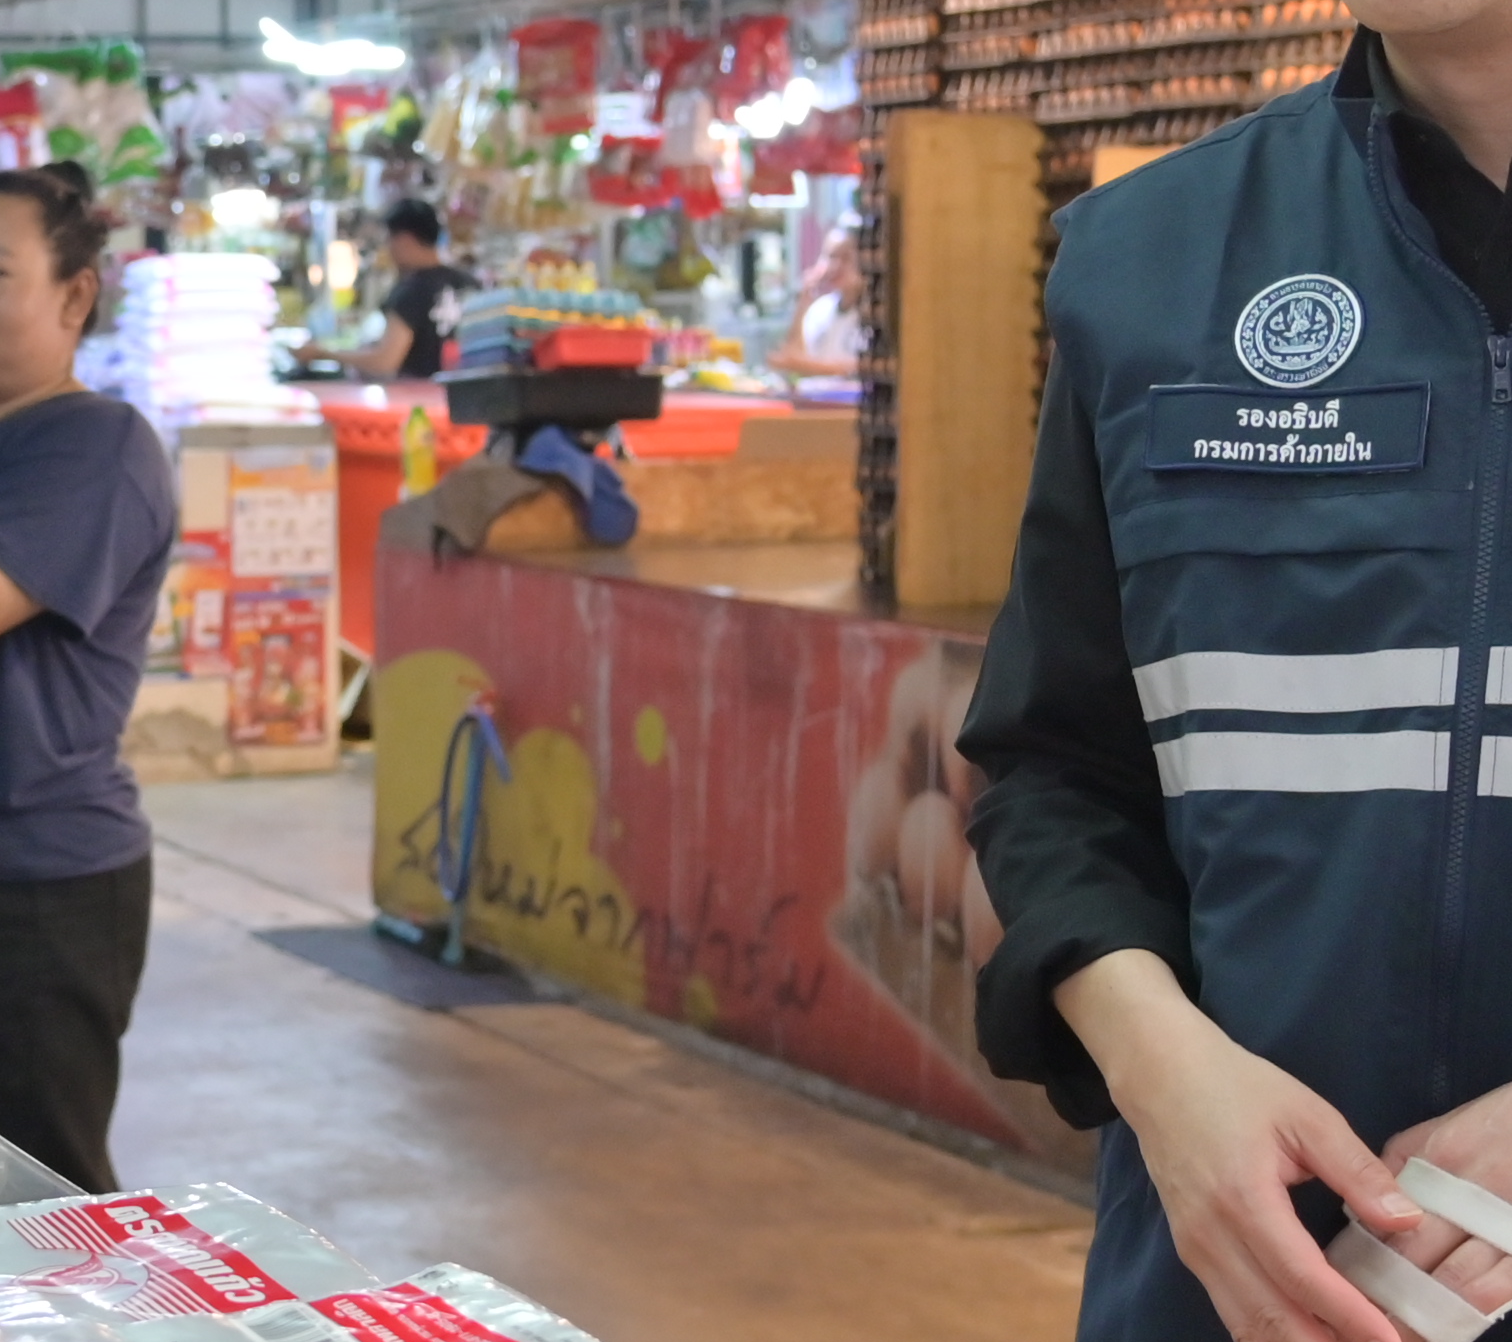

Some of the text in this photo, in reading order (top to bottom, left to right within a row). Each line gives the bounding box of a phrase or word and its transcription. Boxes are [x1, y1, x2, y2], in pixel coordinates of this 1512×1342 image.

[1236, 399, 1341, 429] รองอธิบดี
[1193, 432, 1372, 463] กรมการค้าภายใน
